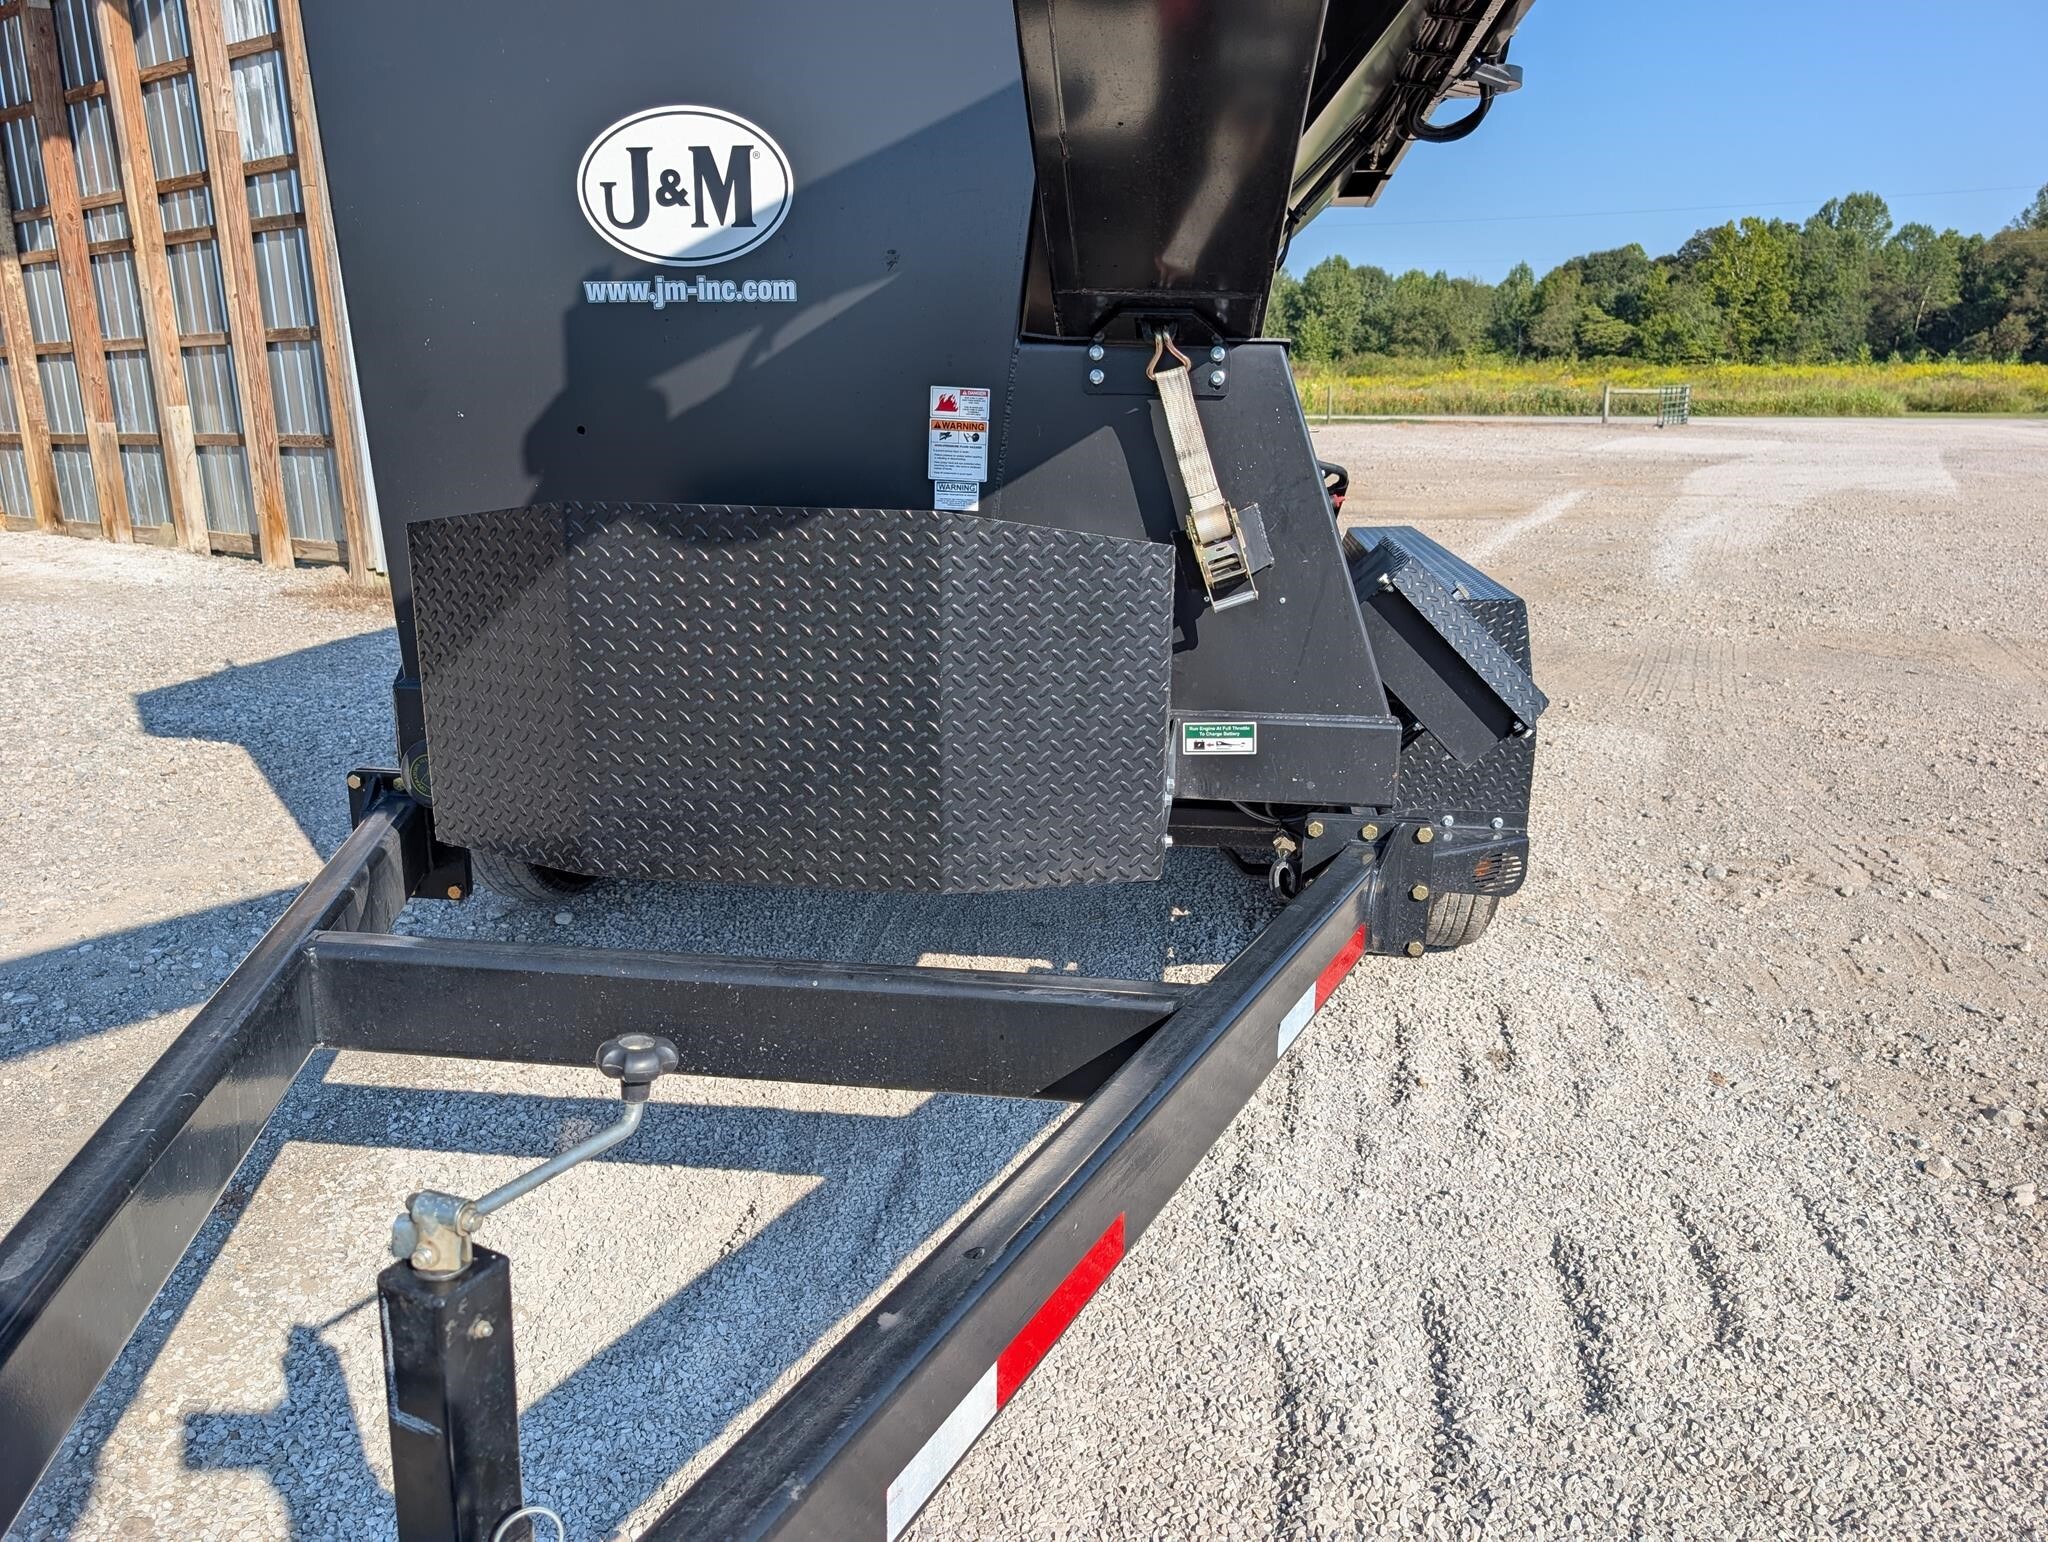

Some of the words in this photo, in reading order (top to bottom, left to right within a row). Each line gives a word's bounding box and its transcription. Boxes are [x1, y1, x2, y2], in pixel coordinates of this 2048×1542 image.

[583, 275, 797, 310] www.jm-inc.com
[941, 421, 985, 431] WARNING
[938, 483, 976, 492] WARNING
